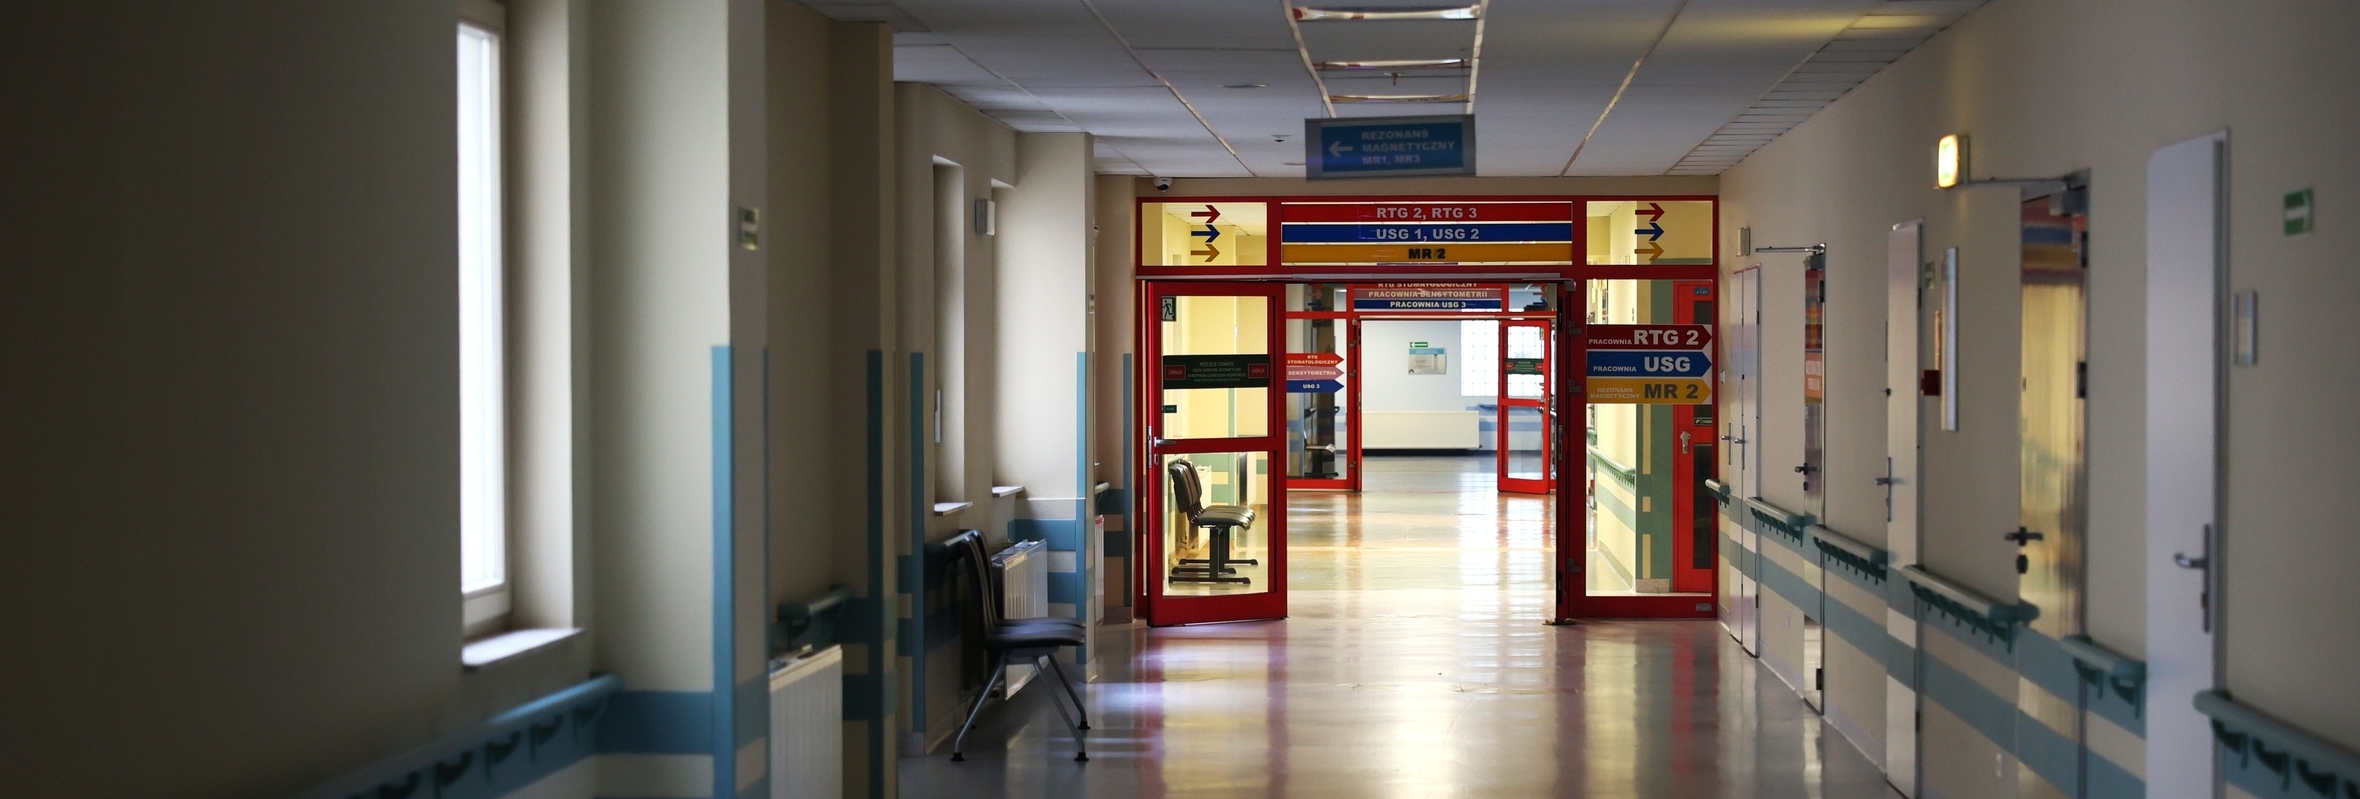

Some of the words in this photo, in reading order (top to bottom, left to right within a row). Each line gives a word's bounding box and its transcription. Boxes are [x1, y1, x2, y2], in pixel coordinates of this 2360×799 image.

[1362, 130, 1429, 140] REZONANS
[1362, 141, 1455, 153] MAGNETYCZNY
[1395, 154, 1420, 164] MR3
[1376, 207, 1409, 219] RTG
[1413, 207, 1427, 221] 2,
[1431, 207, 1463, 219] RTG
[1468, 207, 1478, 219] 3
[1376, 228, 1409, 240] USG
[1414, 228, 1428, 242] 1,
[1432, 228, 1466, 240] USG
[1470, 228, 1480, 240] 2
[1408, 248, 1432, 260] MR
[1436, 248, 1446, 260] 2
[1633, 329, 1679, 346] RTG
[1685, 329, 1699, 345] 2
[1644, 356, 1691, 373] USG
[1644, 383, 1679, 399] MR
[1685, 383, 1699, 399] 2
